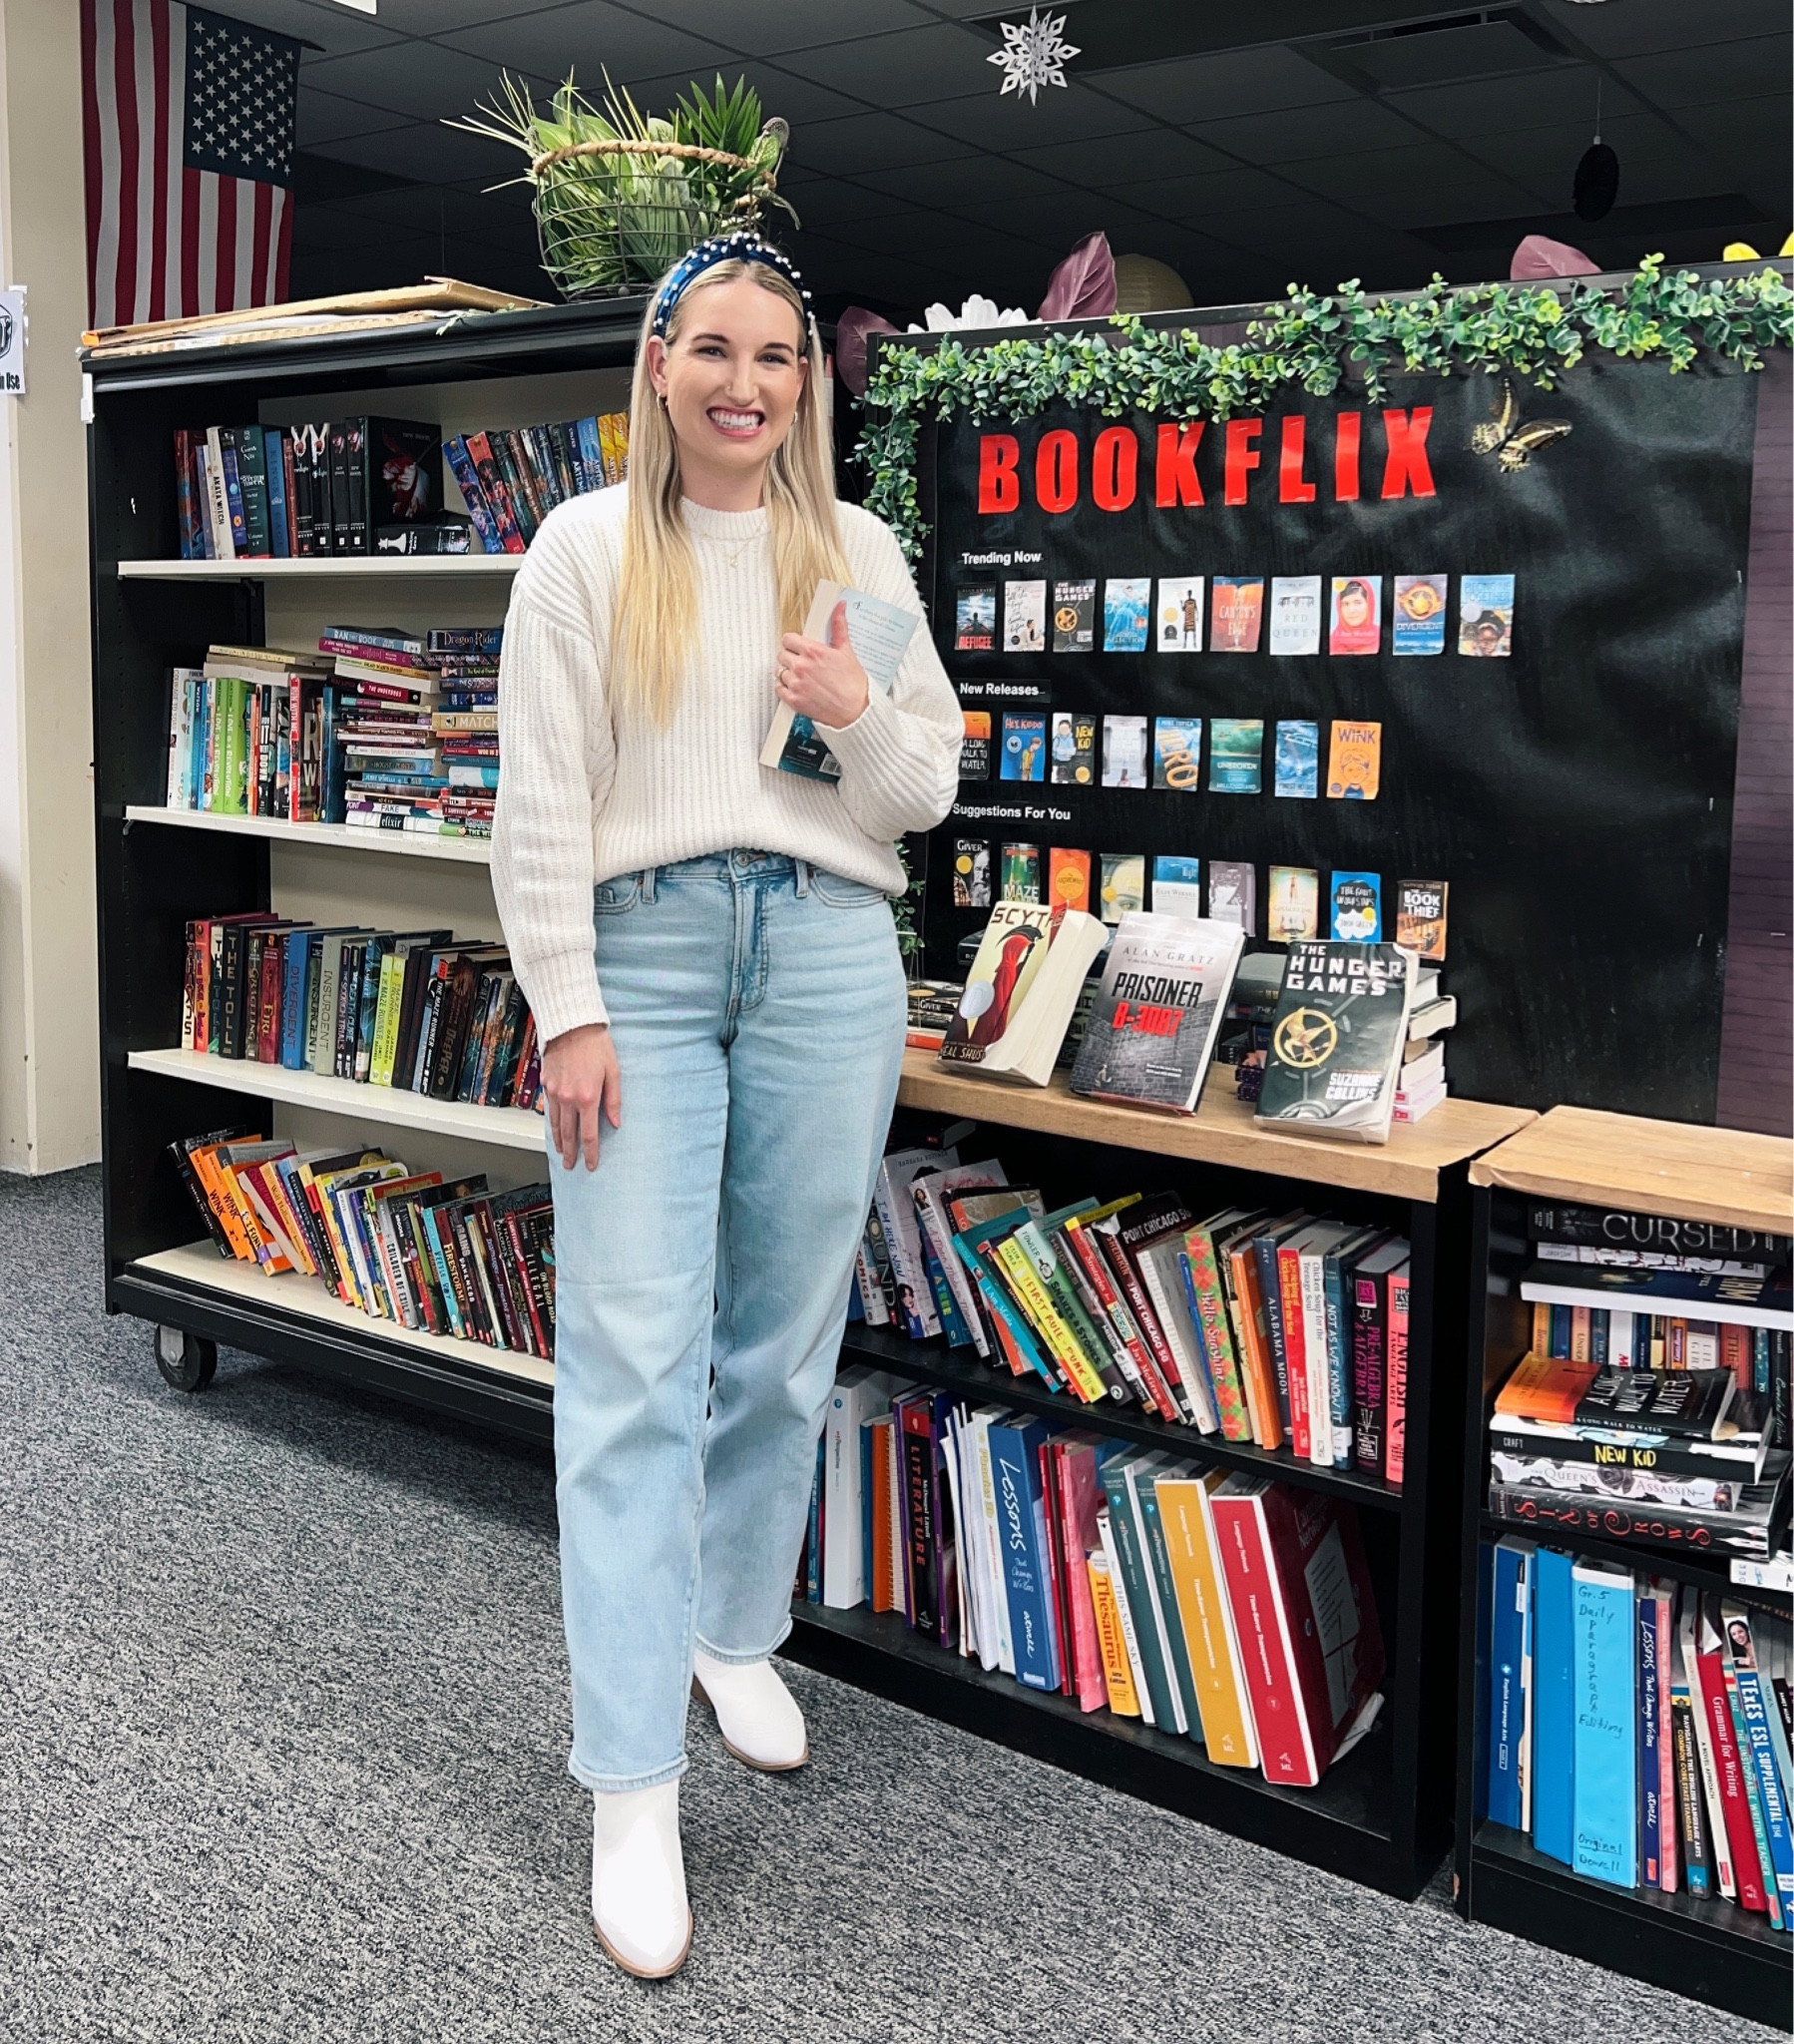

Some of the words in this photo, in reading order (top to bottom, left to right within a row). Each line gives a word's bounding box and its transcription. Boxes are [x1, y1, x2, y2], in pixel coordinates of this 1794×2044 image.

[7, 372, 20, 389] Use
[978, 407, 1436, 514] BOOKFLIX
[962, 552, 1011, 565] Trending
[1014, 551, 1041, 563] Now
[359, 635, 376, 644] BOOK
[444, 632, 473, 646] Dragon
[475, 632, 496, 646] Rider
[958, 636, 992, 649] REFUGEE
[960, 683, 982, 695] New
[987, 685, 1039, 696] Releases
[1076, 726, 1094, 739] NEW
[953, 803, 1021, 817] Suggestions
[1025, 807, 1045, 819] For
[1048, 808, 1071, 820] You
[1004, 884, 1039, 898] MAZE
[1404, 891, 1440, 906] BOOK
[1404, 904, 1440, 918] THIEF
[226, 936, 237, 979] THE
[1123, 946, 1160, 958] ALAN
[1166, 950, 1215, 965] GRATZ
[1300, 945, 1327, 955] THE
[1290, 955, 1403, 978] HUNGER
[1112, 972, 1203, 1009] PRISONER
[1286, 974, 1387, 996] GAMES
[224, 986, 234, 1044] TOLL
[287, 966, 299, 1049] DIVERGENT
[319, 970, 332, 1052] INSURGENT
[1112, 1001, 1184, 1038] B-3087
[438, 1027, 457, 1074] DEEPER
[1325, 1087, 1377, 1101] COLLINS
[1329, 1072, 1382, 1087] SUZANNE
[209, 1189, 225, 1217] WINK
[223, 1192, 239, 1221] WINK
[1122, 1226, 1144, 1244] PORT
[1144, 1212, 1179, 1236] CHICAGO
[1602, 1214, 1756, 1253] CURSED
[444, 1244, 465, 1301] FIRESTORM!
[1302, 1263, 1312, 1292] Teenage
[1312, 1262, 1322, 1291] Chicken
[1022, 1230, 1041, 1258] FOWLER
[1051, 1281, 1075, 1321] SNAKES
[1077, 1325, 1102, 1367] STONES
[1304, 1293, 1313, 1311] Soul
[1312, 1293, 1323, 1313] Soup
[1025, 1277, 1048, 1311] FIRST
[1046, 1312, 1063, 1341] RULE
[1066, 1345, 1086, 1377] PUNK
[1130, 1284, 1144, 1311] PORT
[1140, 1311, 1162, 1348] CHICAGO
[1160, 1348, 1169, 1362] 50
[1326, 1303, 1337, 1327] NOT
[1267, 1296, 1282, 1357] ALABAMA
[1276, 1361, 1288, 1395] MOON
[1328, 1329, 1338, 1343] AS
[1328, 1345, 1339, 1366] WE
[1355, 1333, 1365, 1400] ALGEBRA
[1367, 1325, 1381, 1408] PRE-ALGEBRA
[1329, 1368, 1341, 1408] KNOW
[1630, 1373, 1657, 1385] TO
[1649, 1376, 1693, 1414] WATER
[1332, 1410, 1343, 1423] IT
[1594, 1445, 1627, 1464] NEW
[1544, 1467, 1597, 1484] QUEEN'S
[1636, 1479, 1696, 1497] ASSASSIN
[910, 1446, 926, 1566] LITERATURE
[999, 1457, 1026, 1551] Lessons
[1603, 1509, 1711, 1546] CROWS
[1600, 1590, 1611, 1601] 5
[1096, 1578, 1117, 1669] Thesaurus
[1578, 1605, 1614, 1623] Daily
[1641, 1620, 1656, 1670] Lessons
[1579, 1716, 1623, 1739] Editing
[1712, 1697, 1728, 1743] Grammar
[1683, 1715, 1693, 1758] NAVIGATING
[1750, 1725, 1766, 1750] ESL
[1721, 1743, 1732, 1760] for
[1724, 1761, 1737, 1797] Writing
[1757, 1752, 1781, 1824] SUPPLEMENTAL
